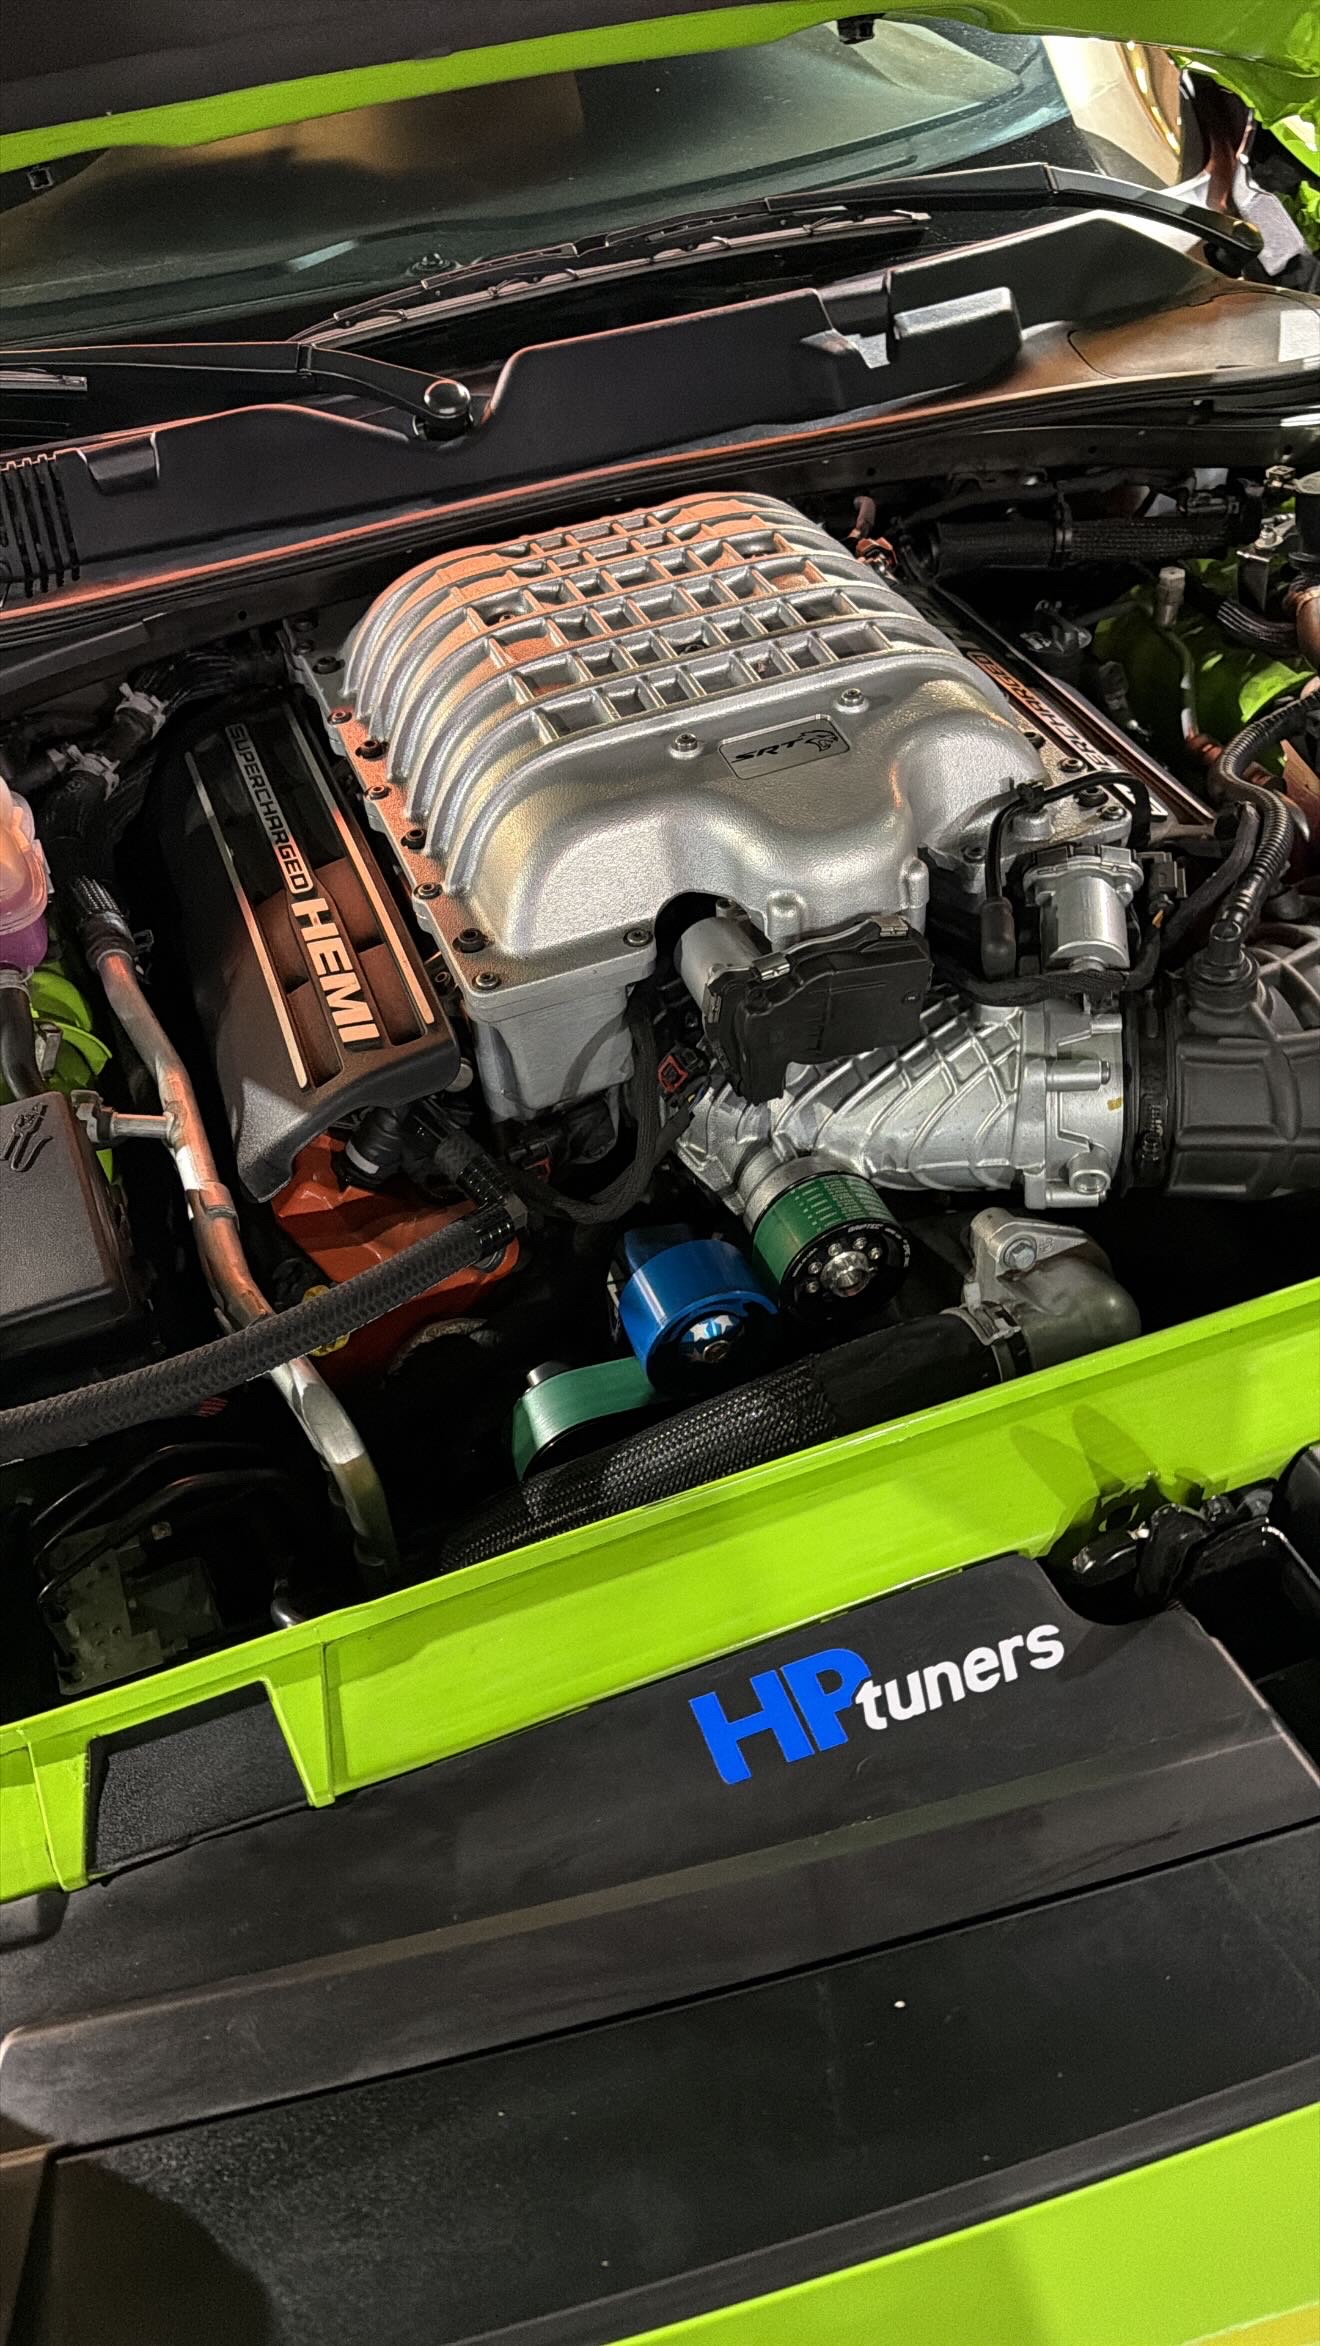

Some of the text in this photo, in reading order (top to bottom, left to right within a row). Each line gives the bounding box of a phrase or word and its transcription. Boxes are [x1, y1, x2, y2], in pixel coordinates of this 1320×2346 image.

[731, 738, 802, 763] SRT
[227, 724, 380, 1044] SUPERCHARGED HEMI
